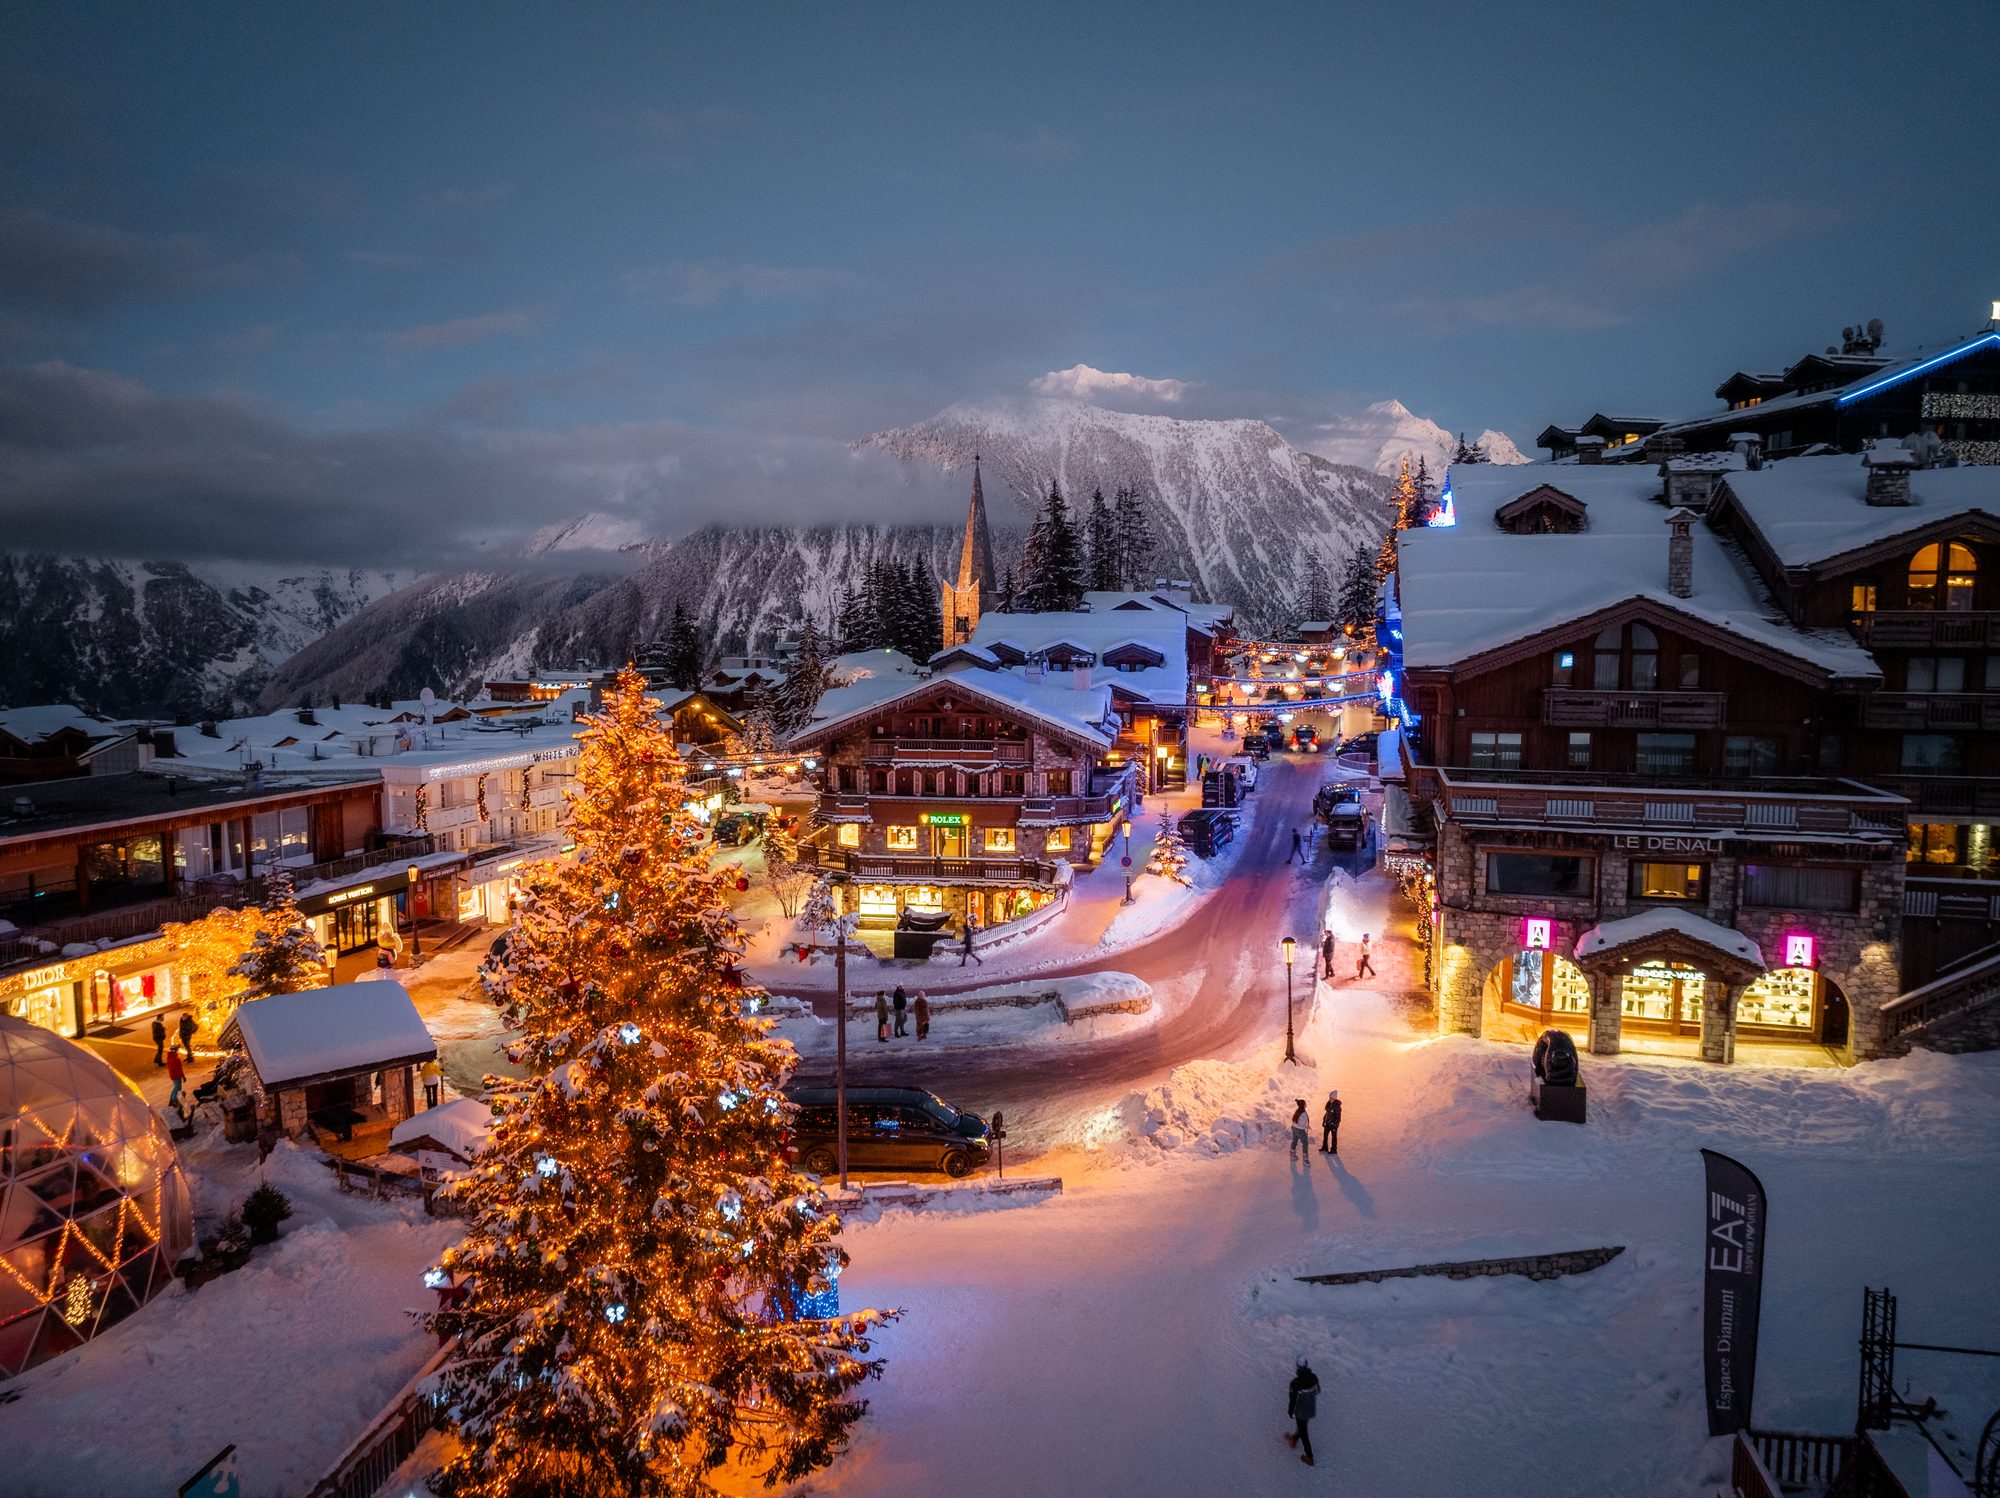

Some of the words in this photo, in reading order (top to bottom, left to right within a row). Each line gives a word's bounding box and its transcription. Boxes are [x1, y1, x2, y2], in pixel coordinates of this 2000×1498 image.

[533, 749, 563, 762] WHITE
[929, 816, 961, 824] ROLEX
[1614, 836, 1640, 849] LE
[1647, 837, 1723, 852] DENALI
[328, 893, 348, 904] LOUIS
[347, 885, 374, 899] VUITTON
[23, 964, 73, 990] DIOR
[1633, 968, 1706, 981] RENDEZ-VOUS
[1710, 1191, 1746, 1273] EA7
[1717, 1288, 1736, 1353] Diamant
[1716, 1357, 1736, 1411] Espace
